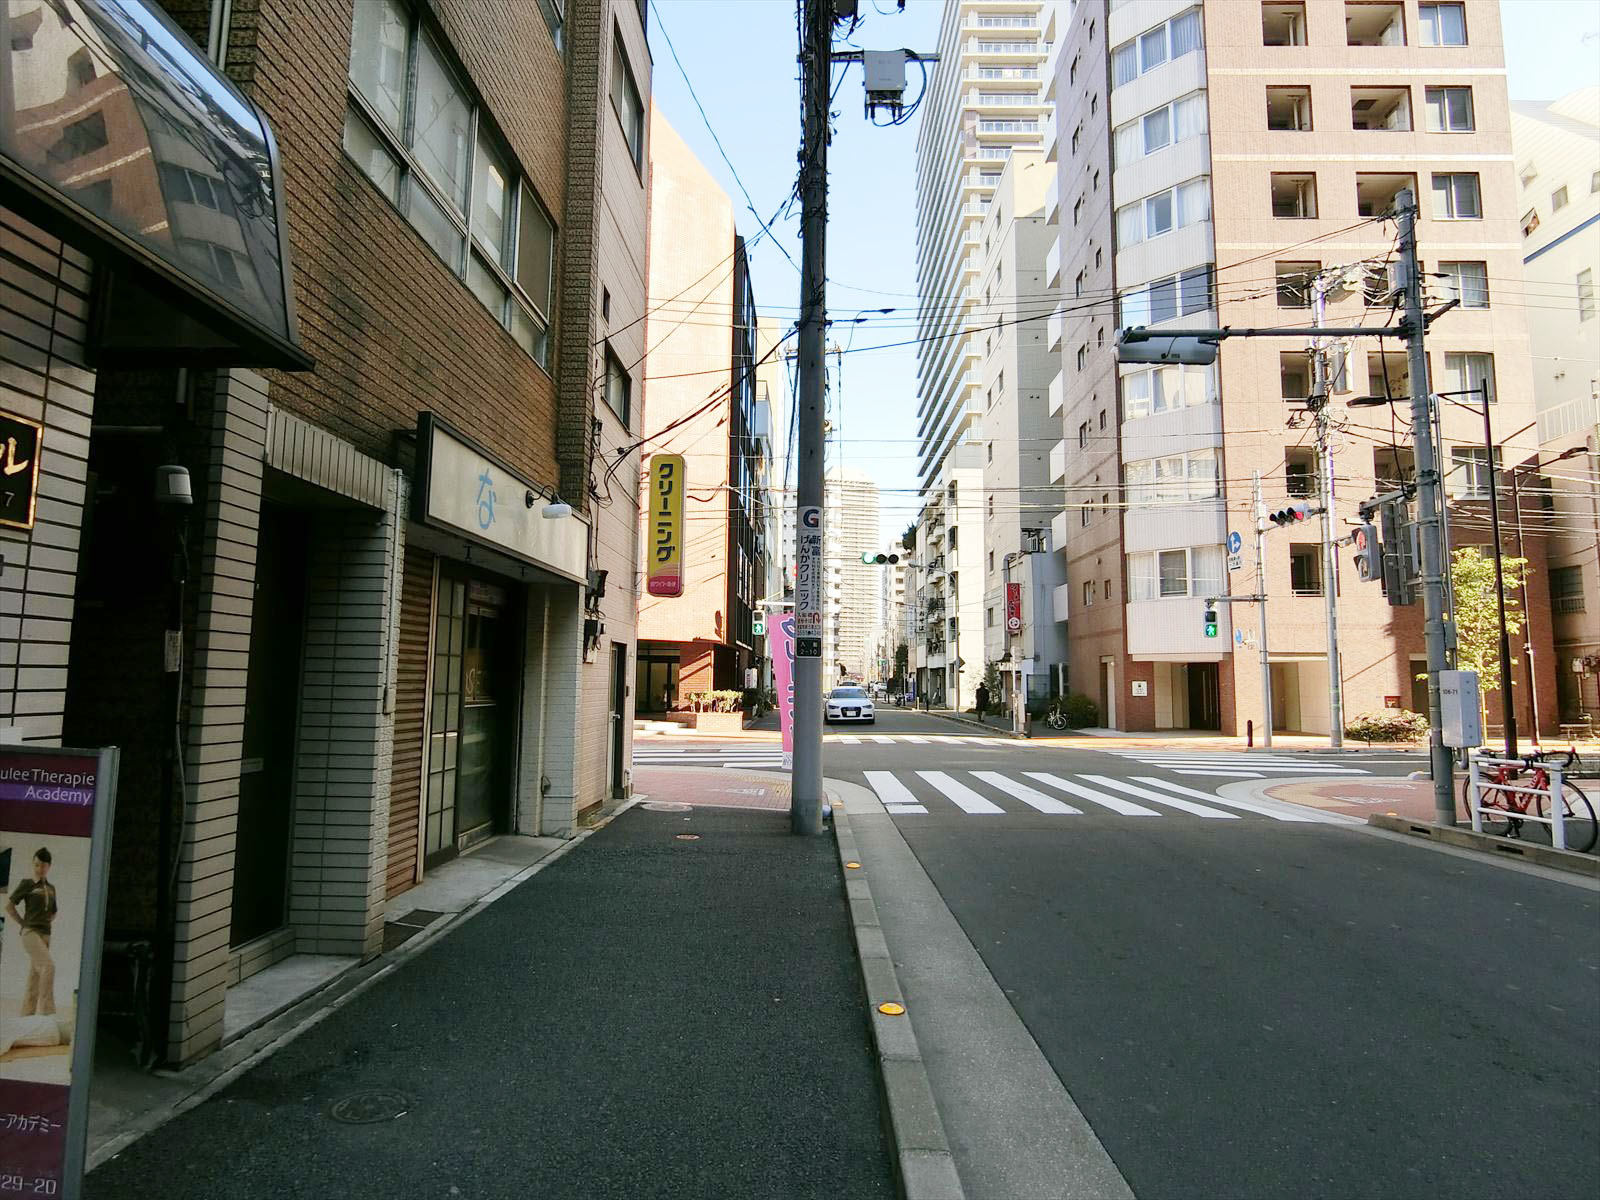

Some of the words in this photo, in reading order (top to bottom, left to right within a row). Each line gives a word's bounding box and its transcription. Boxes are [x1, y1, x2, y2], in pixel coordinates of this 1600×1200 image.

[476, 468, 497, 529] な
[656, 463, 675, 562] クリーニング
[803, 508, 820, 528] G
[799, 535, 811, 611] げんかクリニック
[24, 785, 92, 806] Academy
[31, 768, 95, 788] Therapie
